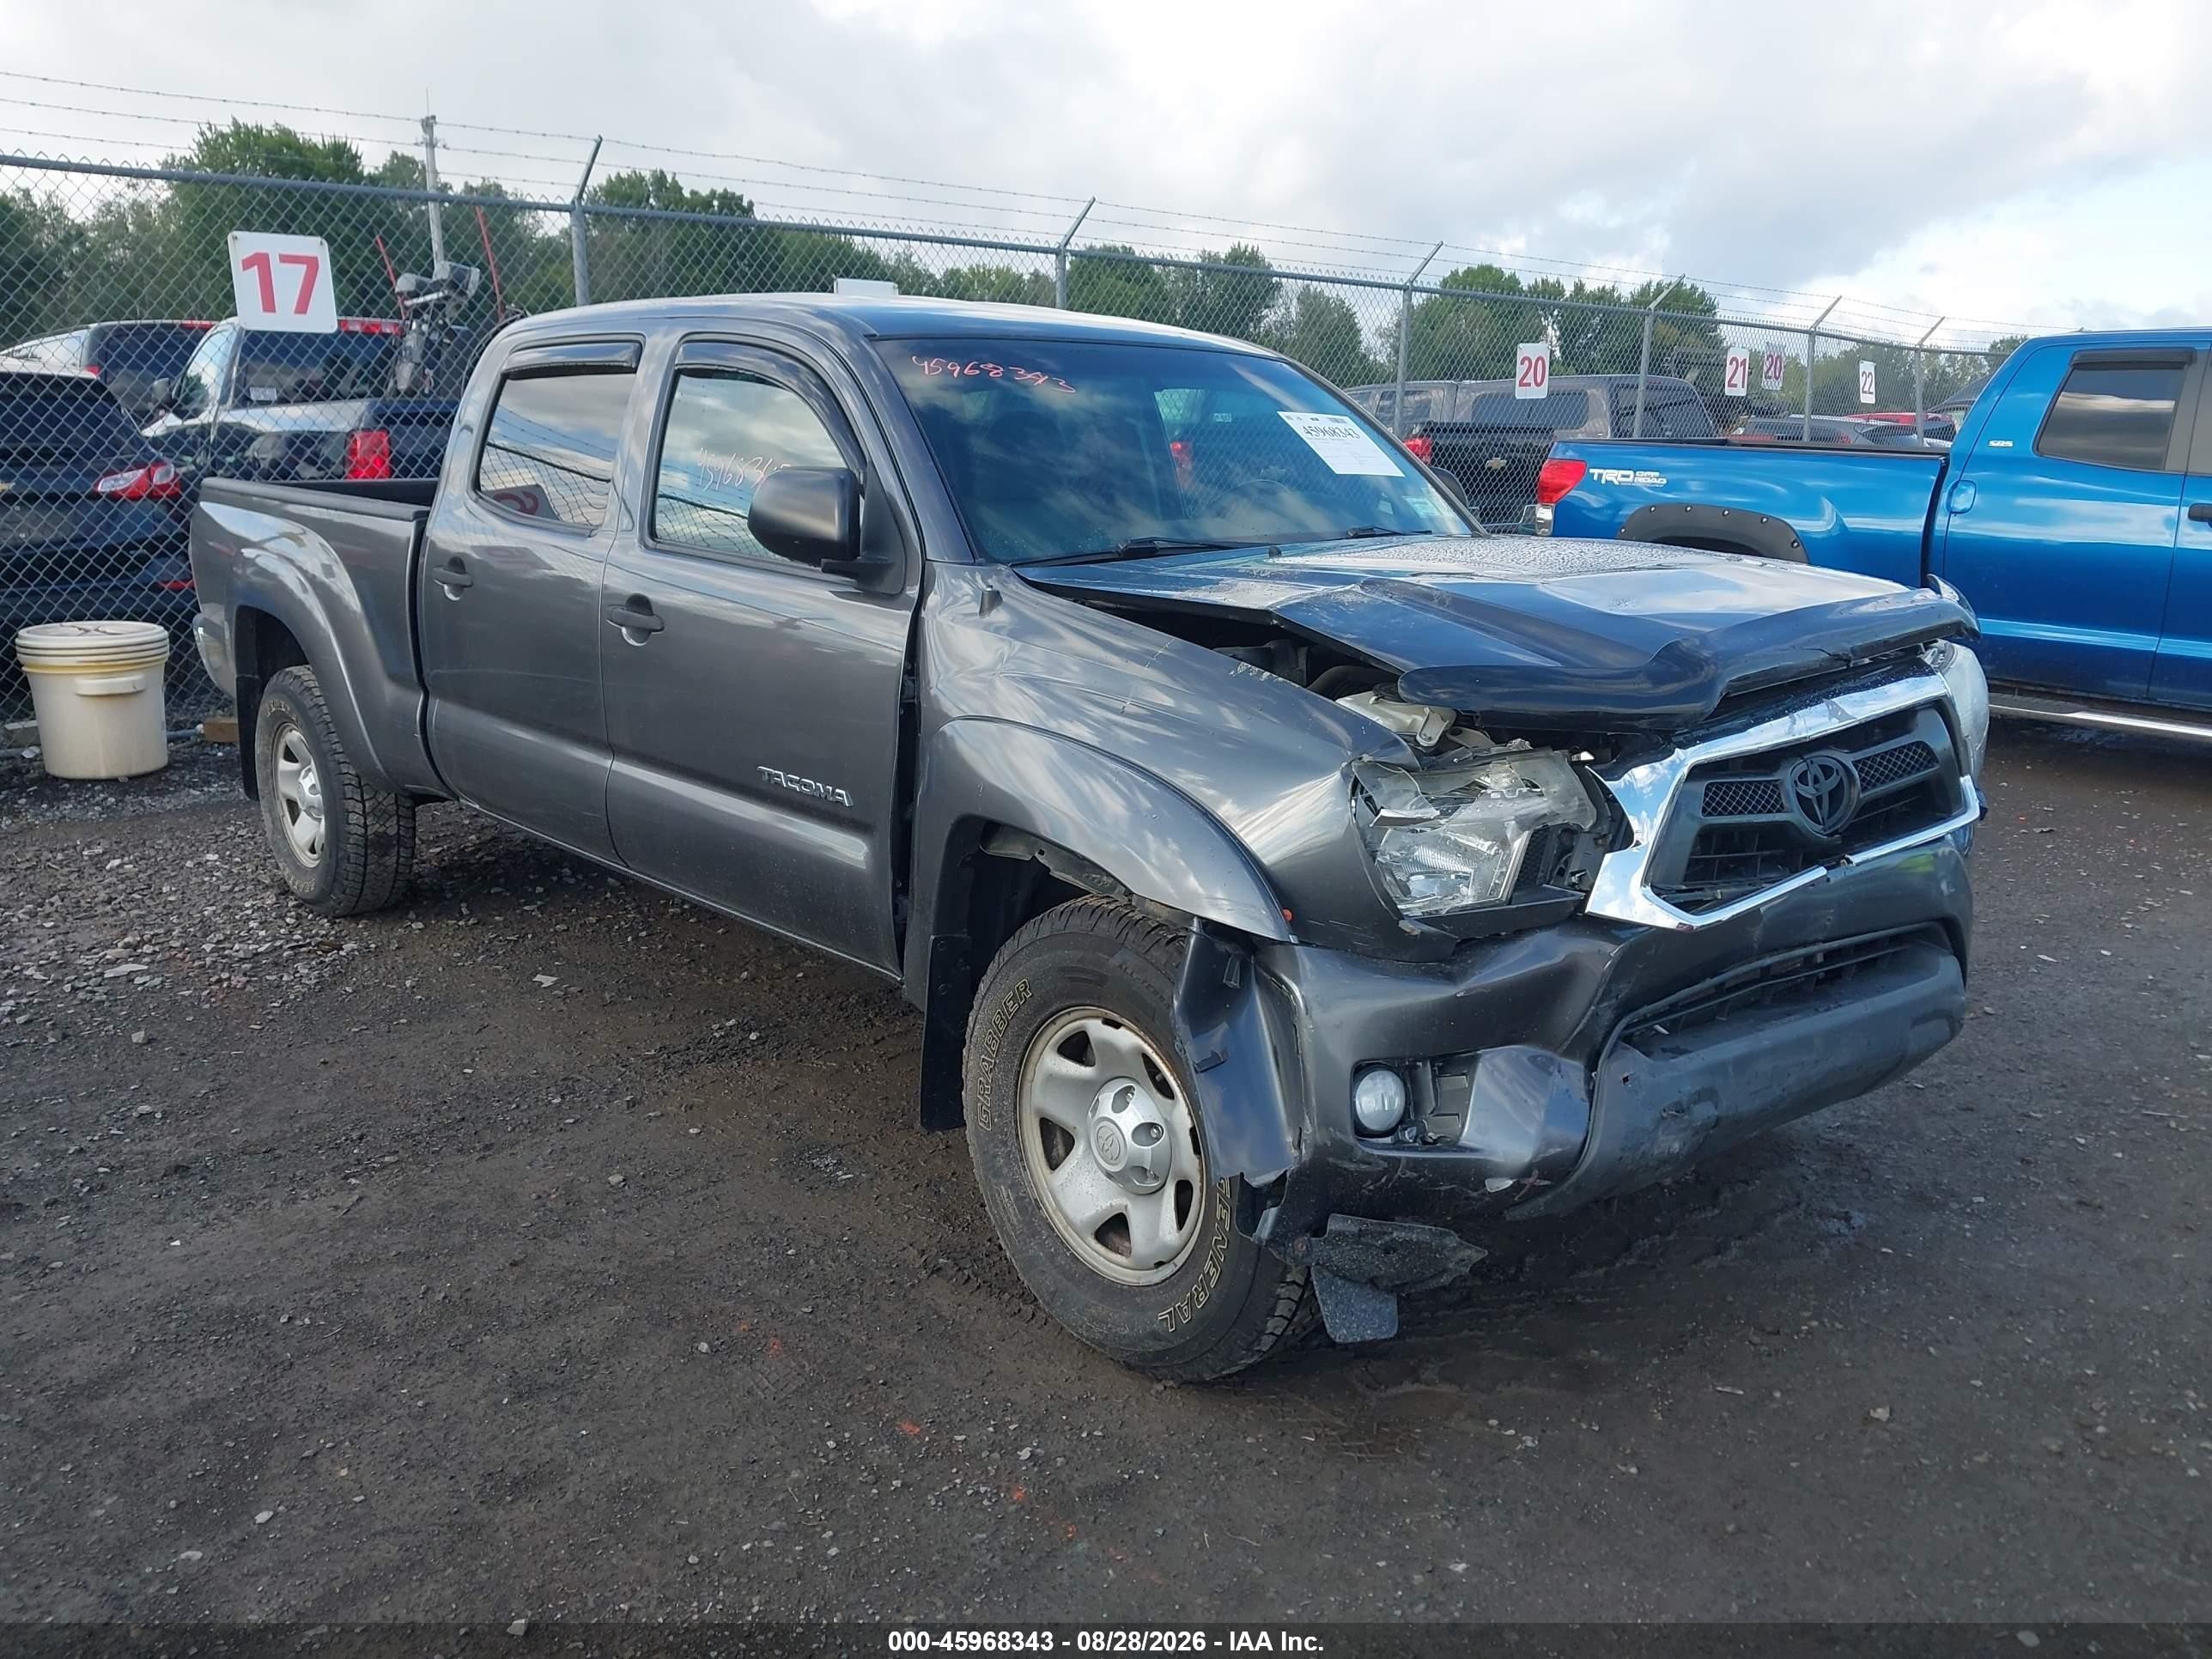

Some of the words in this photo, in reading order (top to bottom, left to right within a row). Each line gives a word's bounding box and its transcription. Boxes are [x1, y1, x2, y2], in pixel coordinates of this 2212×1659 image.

[241, 252, 320, 315] 17
[1518, 356, 1547, 389] 20
[1727, 356, 1747, 389] 21
[1765, 354, 1783, 380] 20
[1861, 371, 1874, 394] 22
[1302, 425, 1361, 440] 45968343
[1589, 468, 1634, 485] TRD
[756, 765, 854, 807] TACOMA
[975, 977, 1033, 1133] GRABBER
